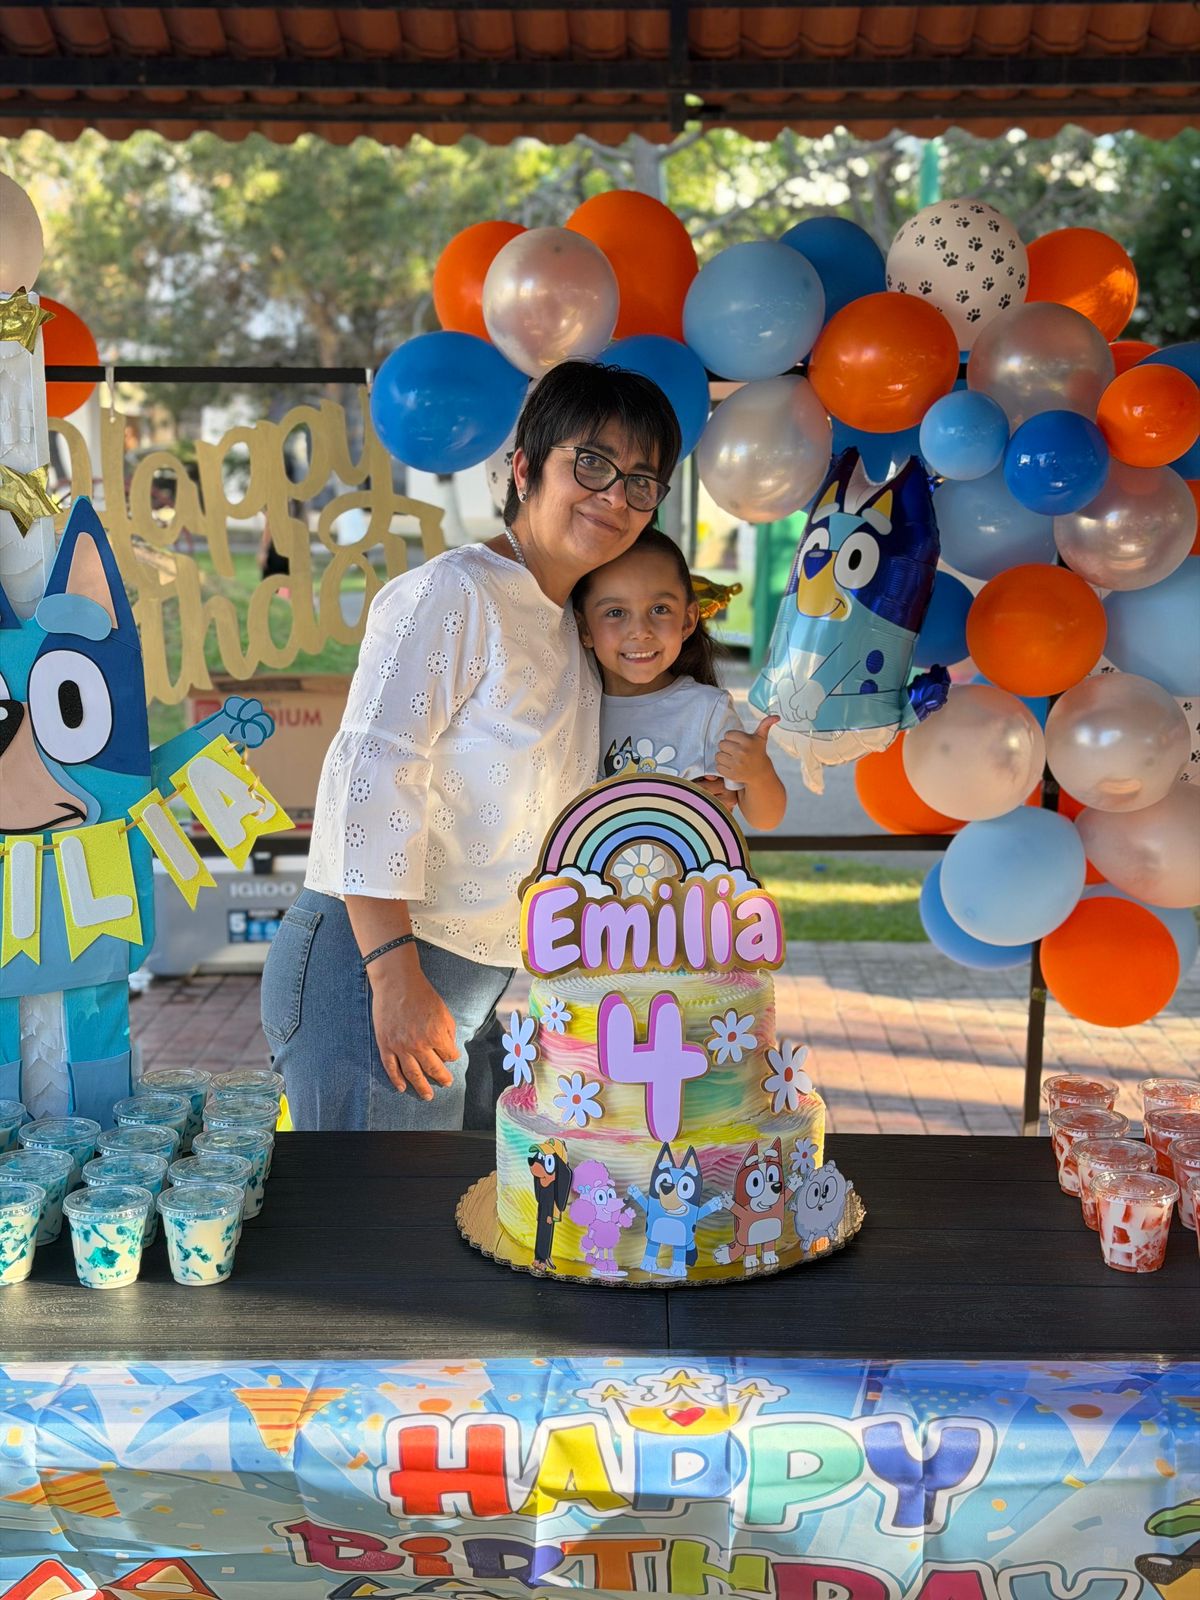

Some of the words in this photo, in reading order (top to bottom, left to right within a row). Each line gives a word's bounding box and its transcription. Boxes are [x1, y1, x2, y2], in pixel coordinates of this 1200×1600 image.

[11, 757, 276, 939] ILIA
[527, 878, 783, 974] Emilia
[598, 992, 709, 1143] 4
[384, 1416, 988, 1532] HAPPY
